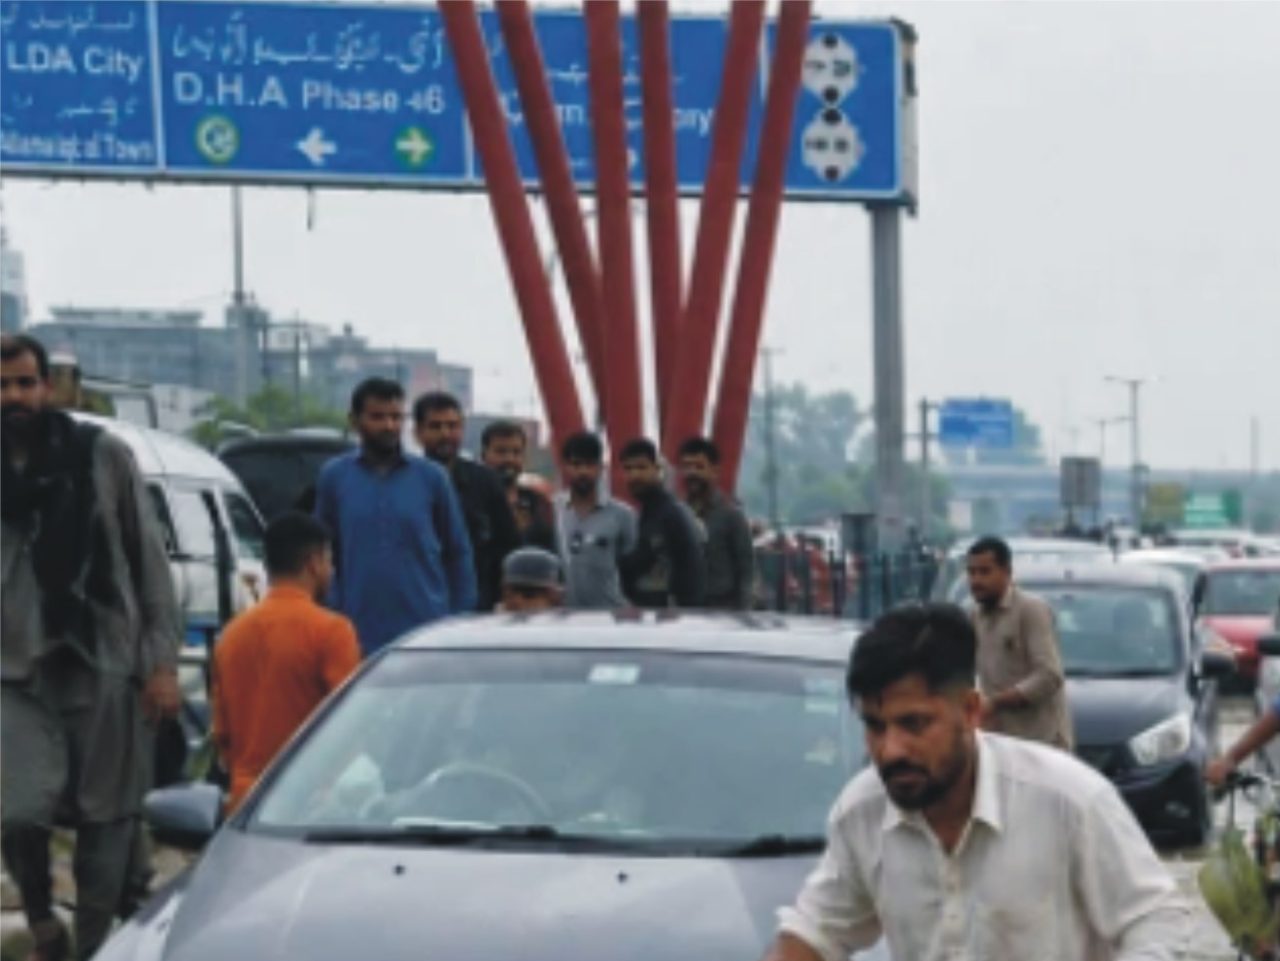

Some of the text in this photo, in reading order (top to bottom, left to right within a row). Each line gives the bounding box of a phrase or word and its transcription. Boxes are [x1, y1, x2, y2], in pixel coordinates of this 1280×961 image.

[6, 41, 145, 85] LDA City
[173, 71, 288, 109] D.H.A
[302, 78, 398, 115] Phase
